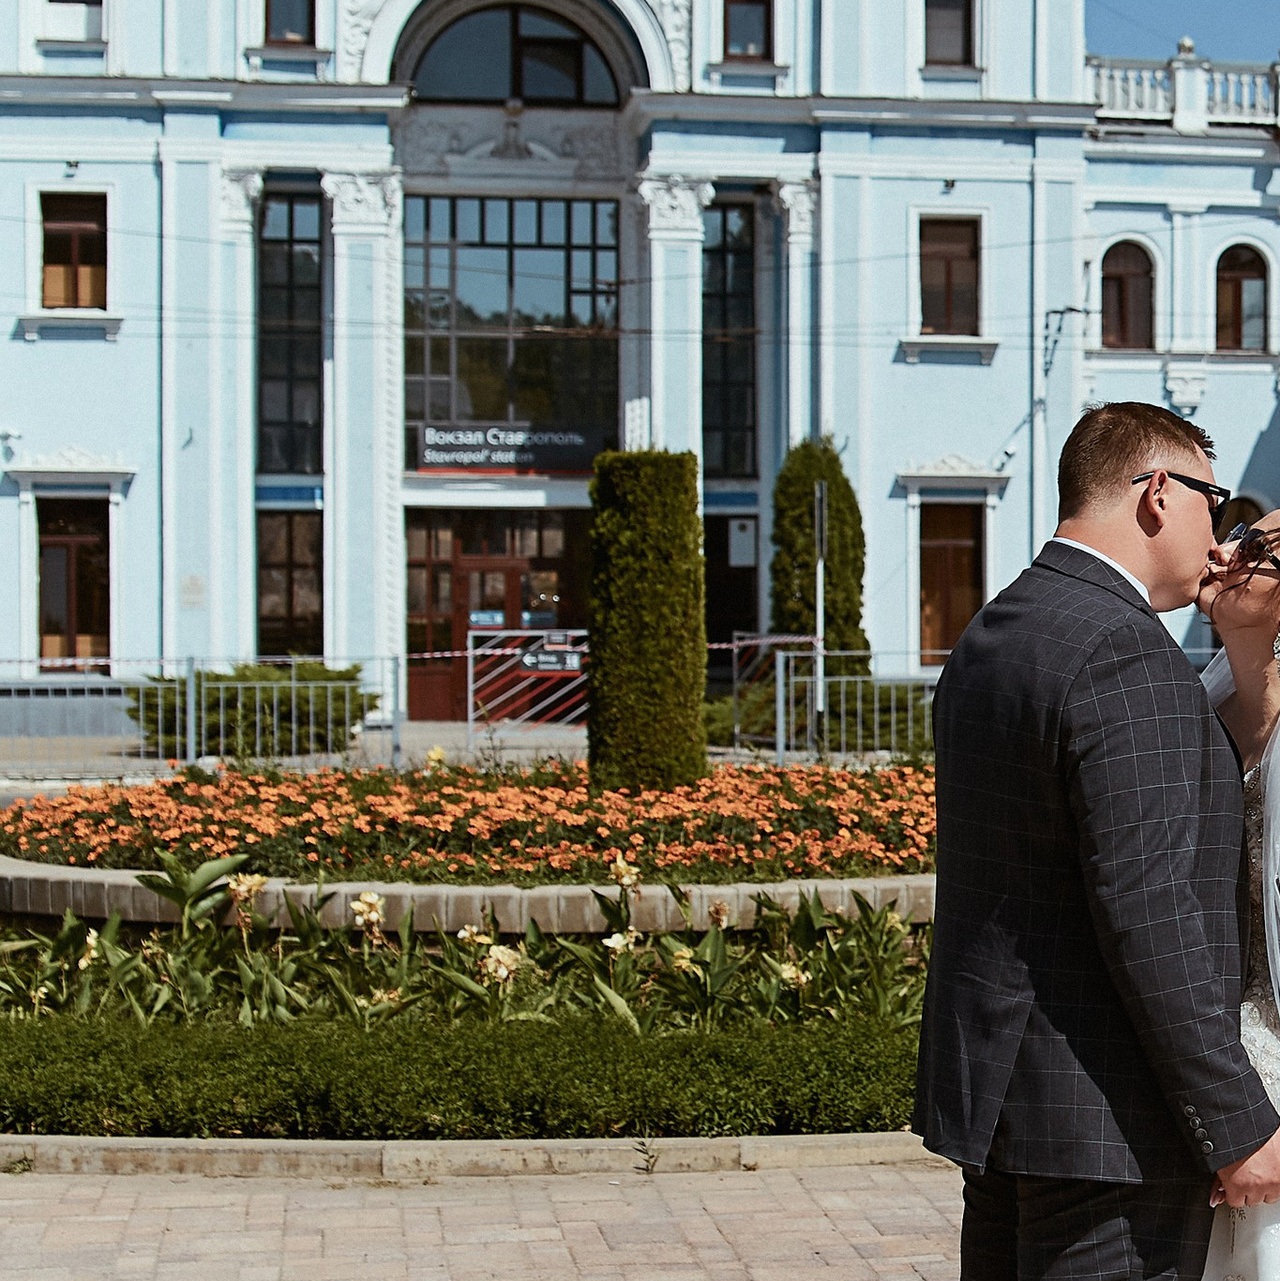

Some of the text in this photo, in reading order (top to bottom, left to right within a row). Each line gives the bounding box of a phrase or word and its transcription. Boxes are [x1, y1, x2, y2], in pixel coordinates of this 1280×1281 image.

[424, 427, 585, 447] Вокзал Ставрополь
[488, 449, 533, 463] staton
